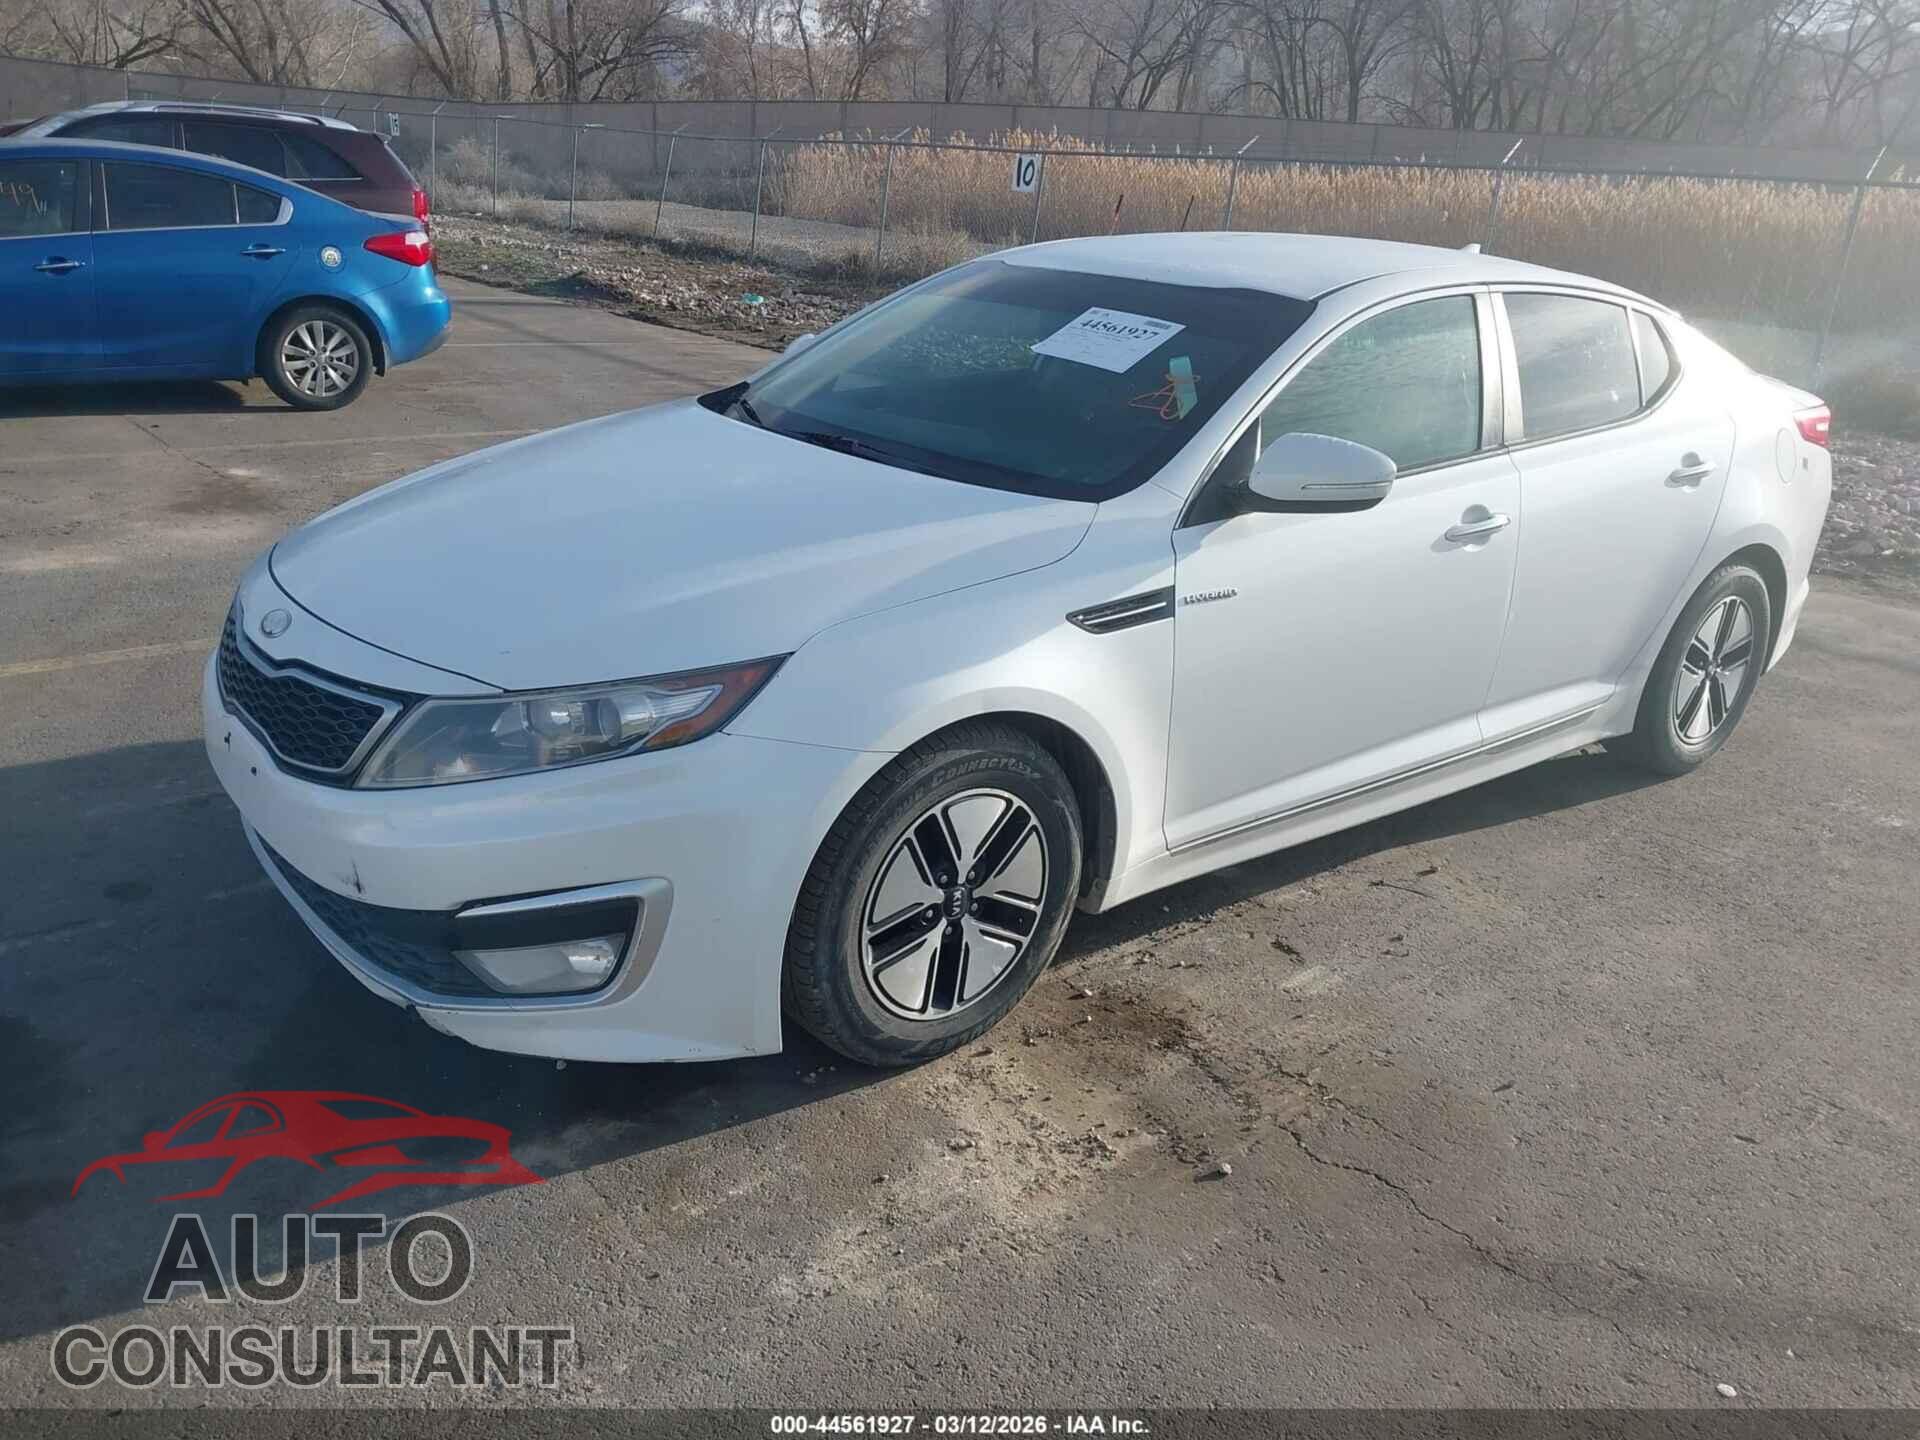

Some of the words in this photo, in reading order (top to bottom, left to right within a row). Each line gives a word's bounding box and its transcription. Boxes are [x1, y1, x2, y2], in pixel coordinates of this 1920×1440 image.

[1017, 157, 1035, 188] 10
[1080, 319, 1159, 340] 44561927
[952, 890, 961, 915] KIA
